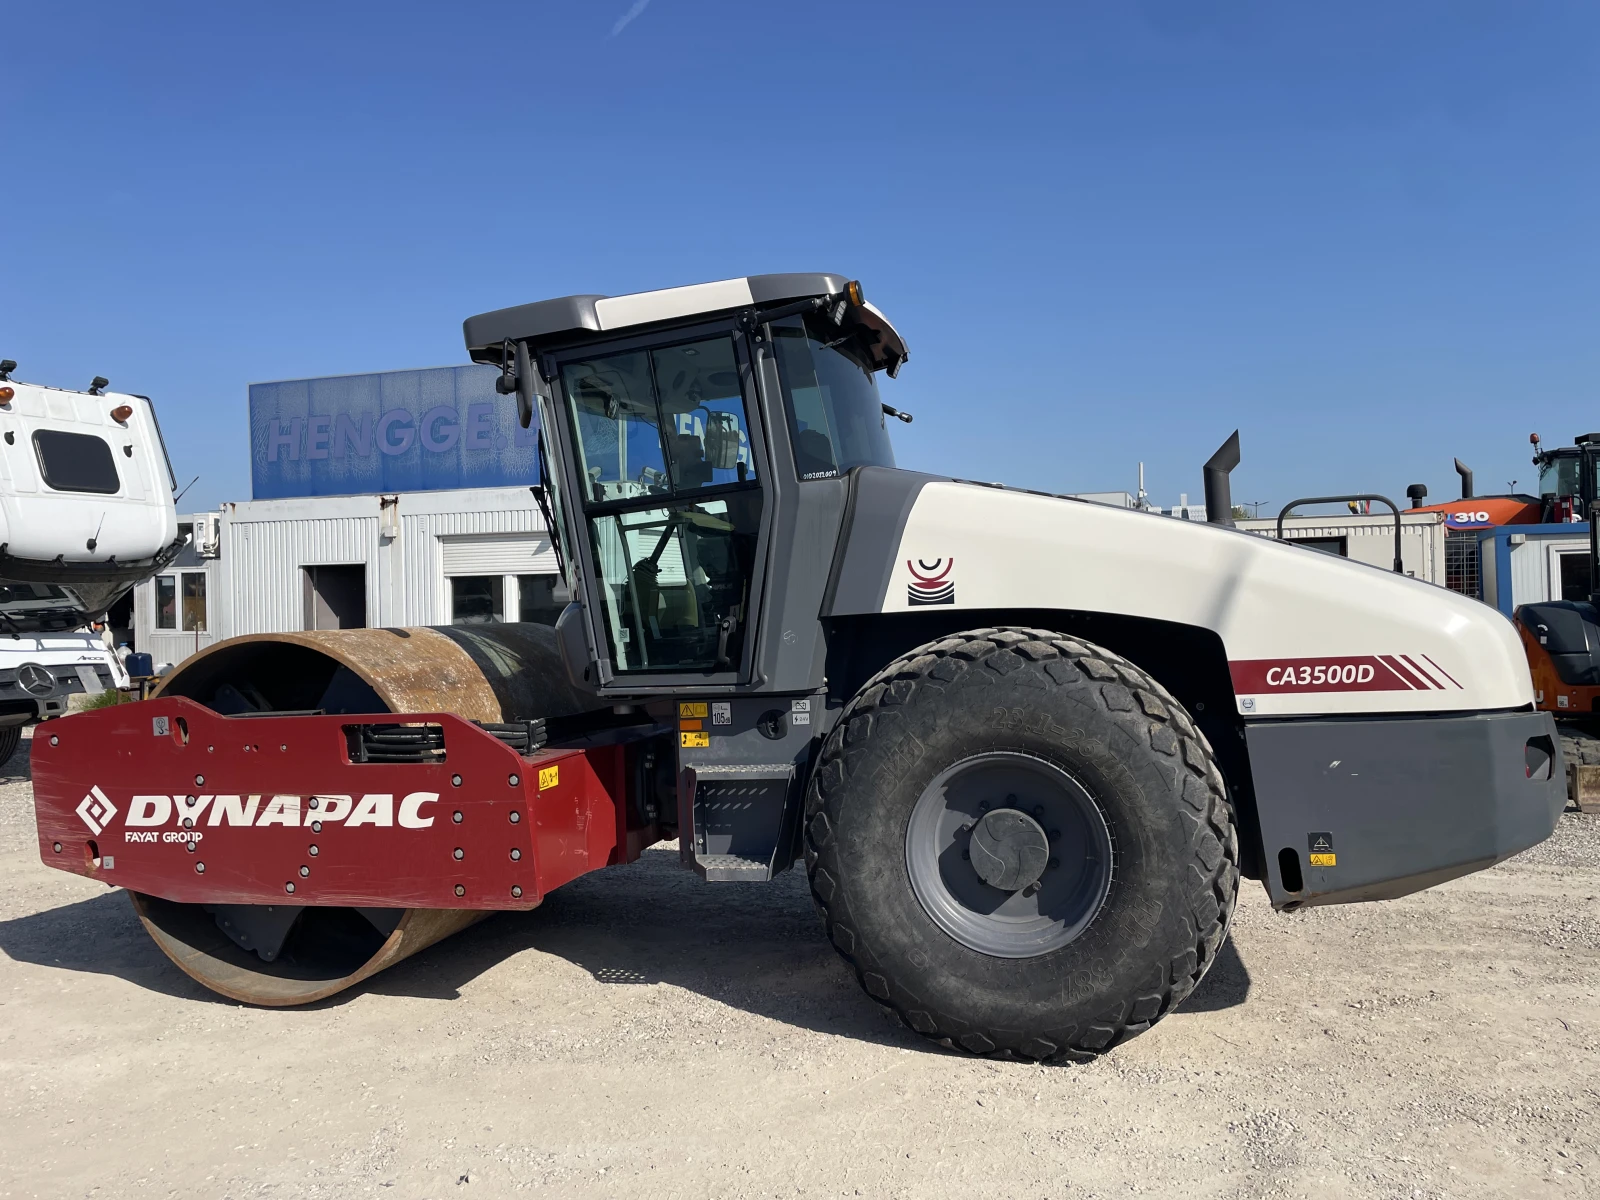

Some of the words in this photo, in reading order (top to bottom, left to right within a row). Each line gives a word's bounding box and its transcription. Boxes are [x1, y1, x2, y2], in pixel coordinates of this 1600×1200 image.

[1455, 511, 1490, 523] 310
[1266, 664, 1375, 686] CA3500D
[125, 792, 440, 829] DYNAPAC
[125, 831, 159, 843] FAYAT
[162, 831, 203, 843] GROUP
